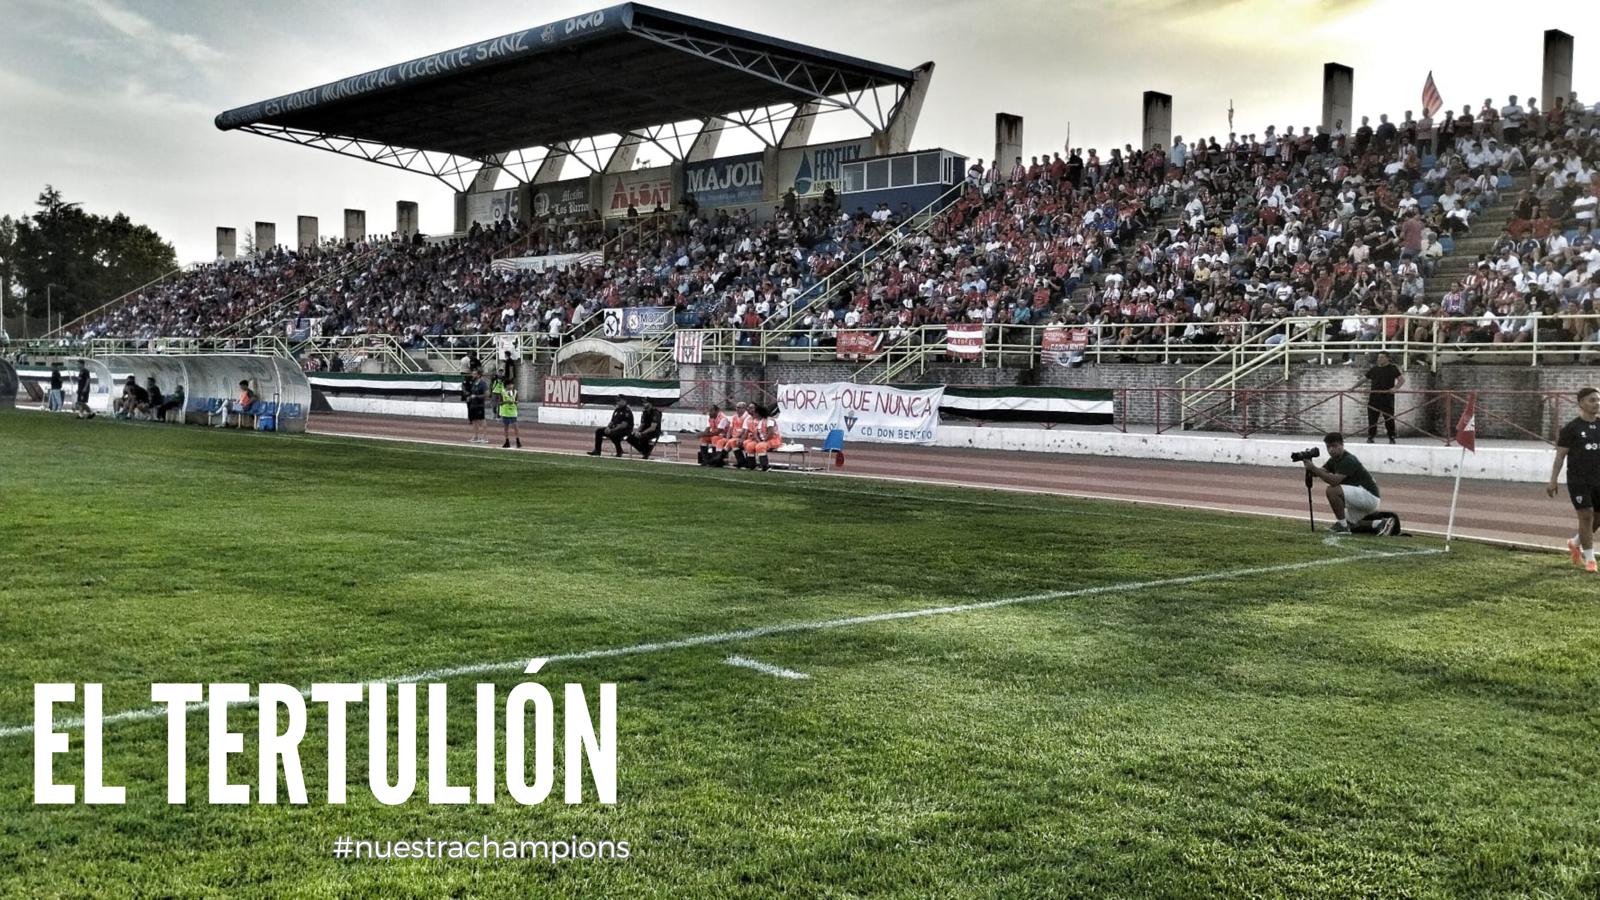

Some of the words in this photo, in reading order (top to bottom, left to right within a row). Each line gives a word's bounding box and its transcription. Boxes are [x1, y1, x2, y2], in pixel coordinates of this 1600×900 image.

[322, 67, 396, 102] MUNICIPAL
[399, 47, 471, 80] VICENTE
[476, 31, 529, 60] SANZ
[544, 379, 579, 403] PAVO
[777, 389, 828, 410] AHORA
[874, 391, 932, 418] NUNCA
[791, 423, 806, 432] LOS
[861, 426, 873, 436] CD
[877, 427, 895, 438] DON
